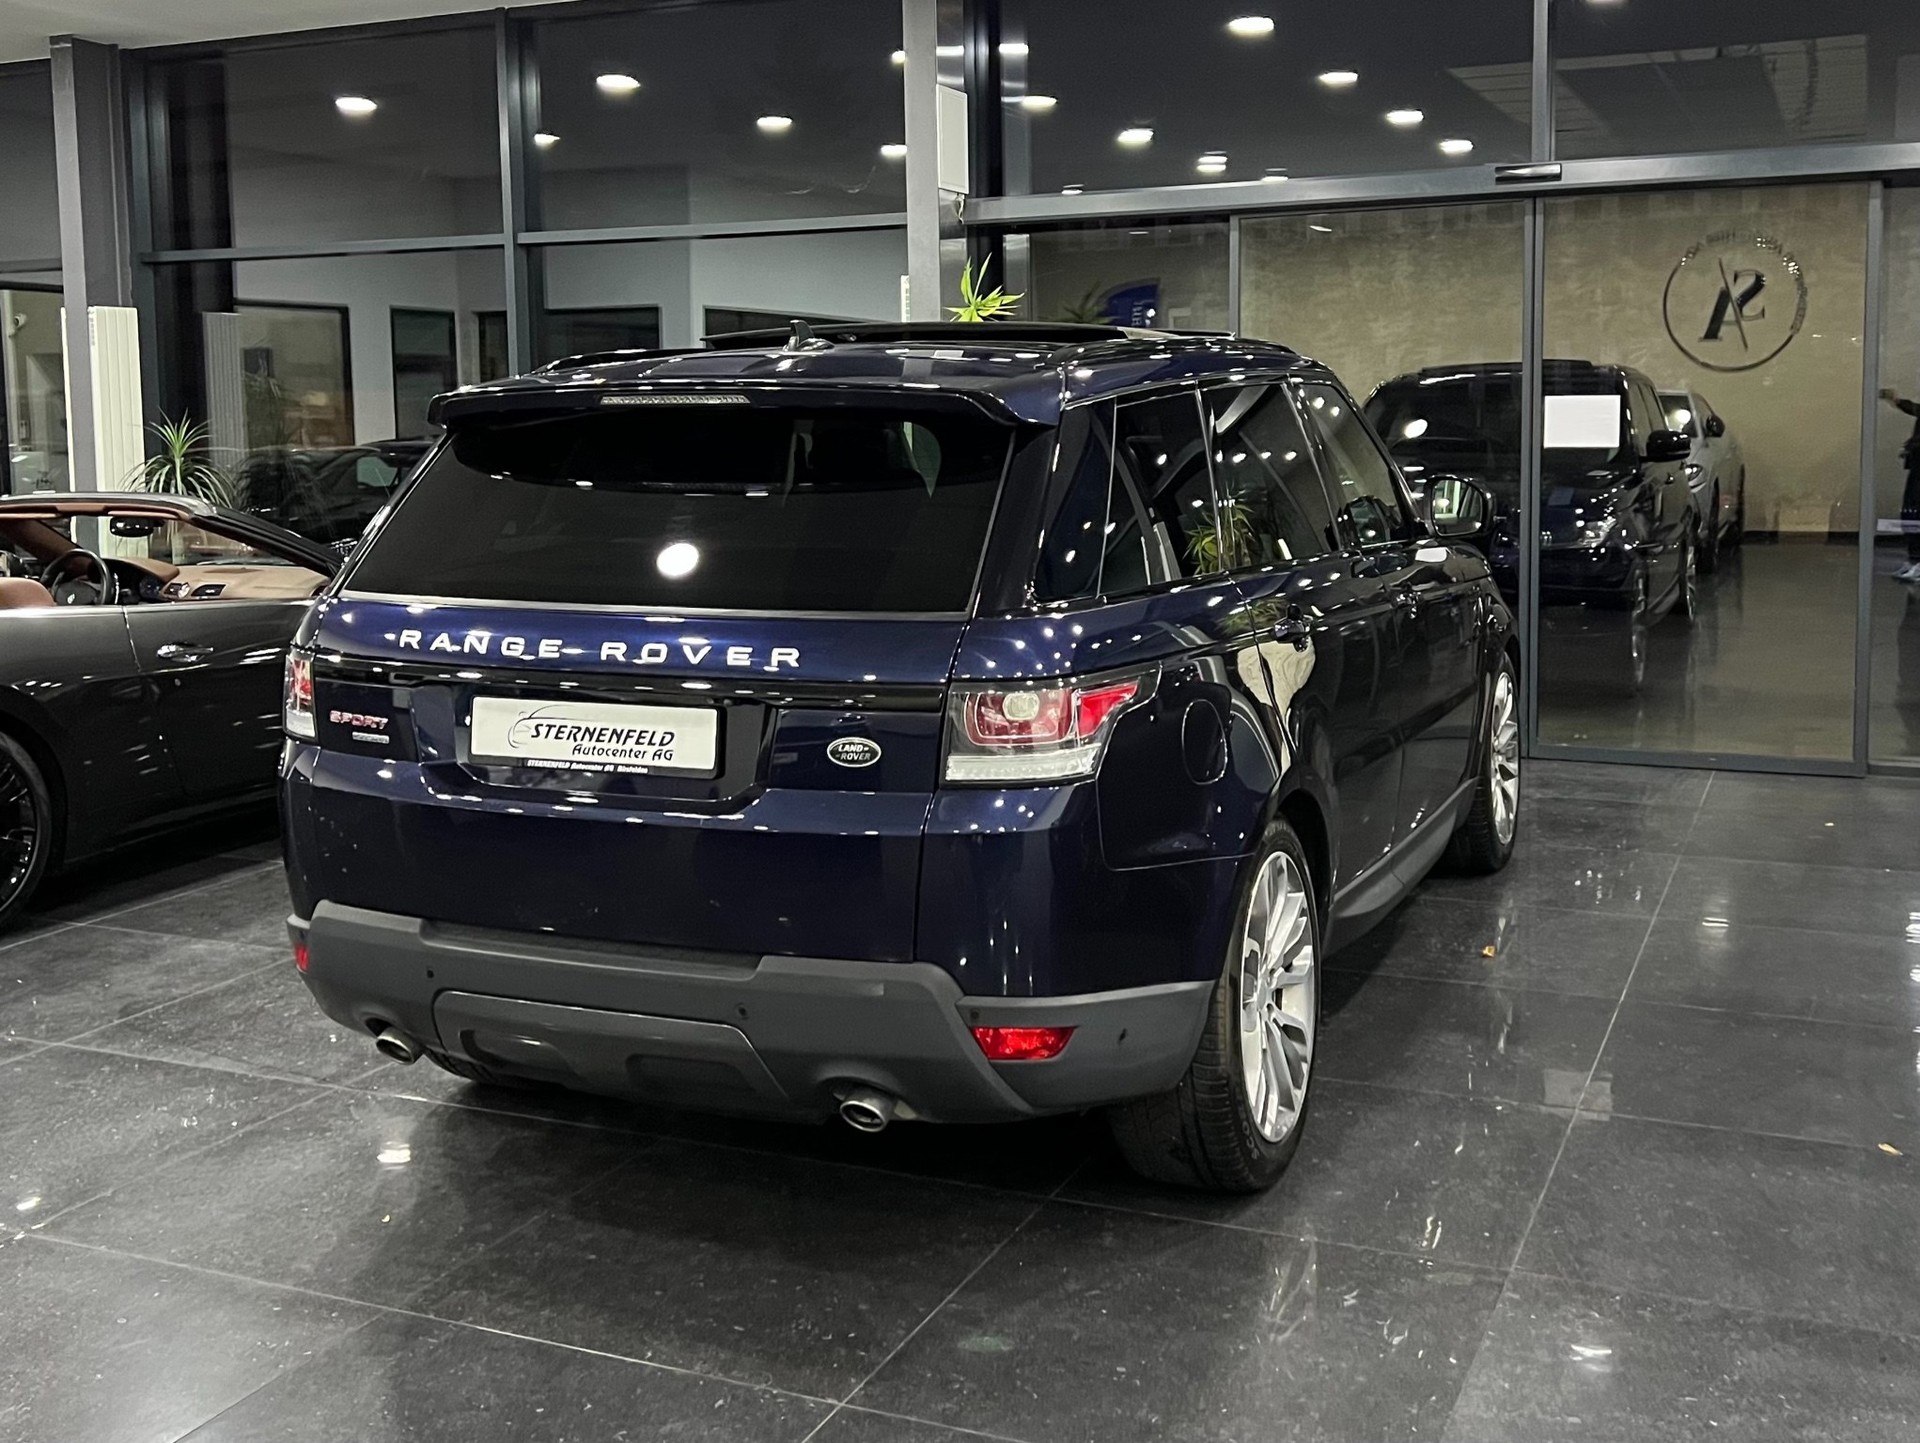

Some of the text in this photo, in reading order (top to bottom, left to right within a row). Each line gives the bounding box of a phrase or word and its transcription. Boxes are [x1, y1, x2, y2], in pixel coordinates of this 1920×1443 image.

[398, 629, 801, 668] RANGE ROVER
[329, 709, 389, 730] SPORT
[532, 724, 675, 747] STERNENFELD
[572, 744, 675, 761] Autocenter AG
[527, 760, 570, 769] STERNENFELD
